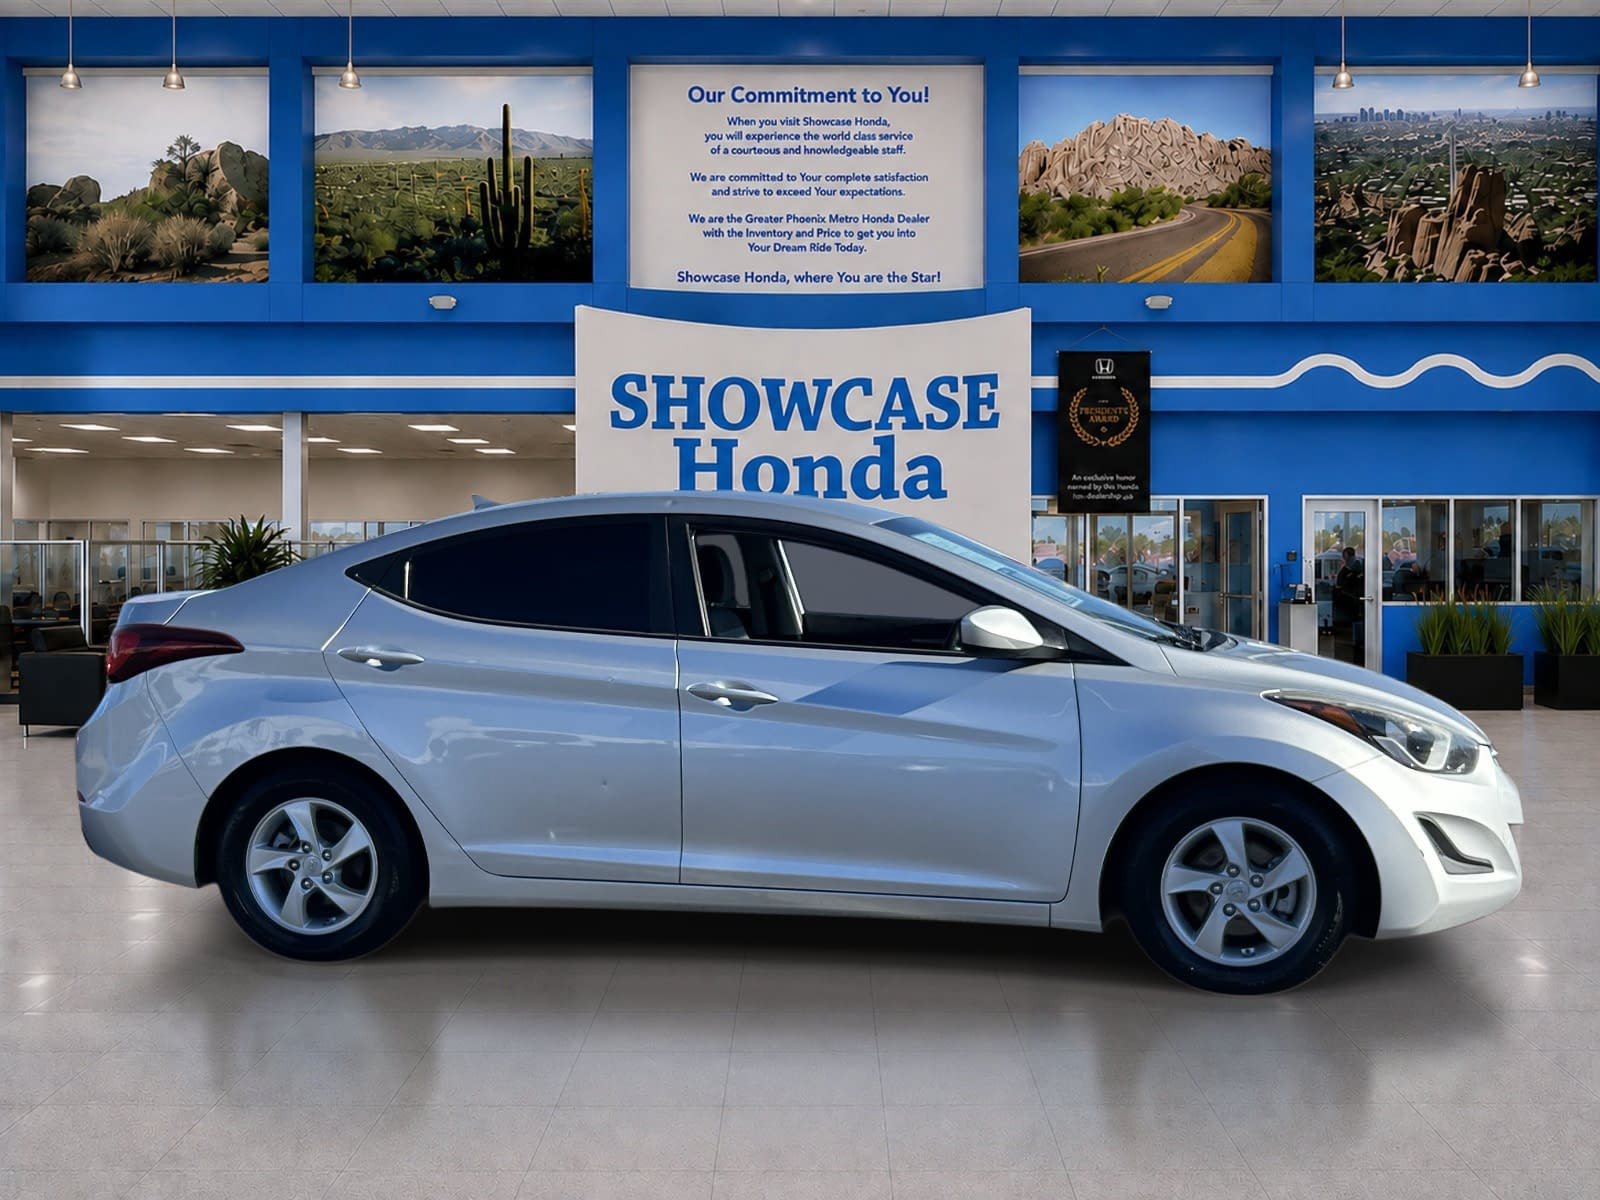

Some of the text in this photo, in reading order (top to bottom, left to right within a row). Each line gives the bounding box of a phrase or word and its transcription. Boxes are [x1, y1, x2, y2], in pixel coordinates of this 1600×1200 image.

[687, 85, 929, 104] Our Commitment to You!
[726, 116, 891, 129] When you visit Showcase Honda,
[704, 130, 913, 143] you will experience the world class service
[710, 144, 721, 155] of
[722, 147, 729, 155] a
[730, 146, 781, 155] courteous
[782, 144, 802, 155] and
[881, 144, 906, 155] staff.
[689, 171, 929, 185] We are committed to Your complete satisfaction
[711, 186, 906, 200] and strive to exceed Your expectations.
[688, 213, 930, 224] We are the Greater Phoenix Metro Honda Dealer
[702, 227, 916, 241] with the Inventory and Price to get you into
[747, 242, 867, 255] Your Dream Ride Today.
[676, 270, 941, 285] Showcase Honda, where You are the Star!
[610, 373, 1000, 431] SHOWCASE
[673, 434, 948, 500] Honda
